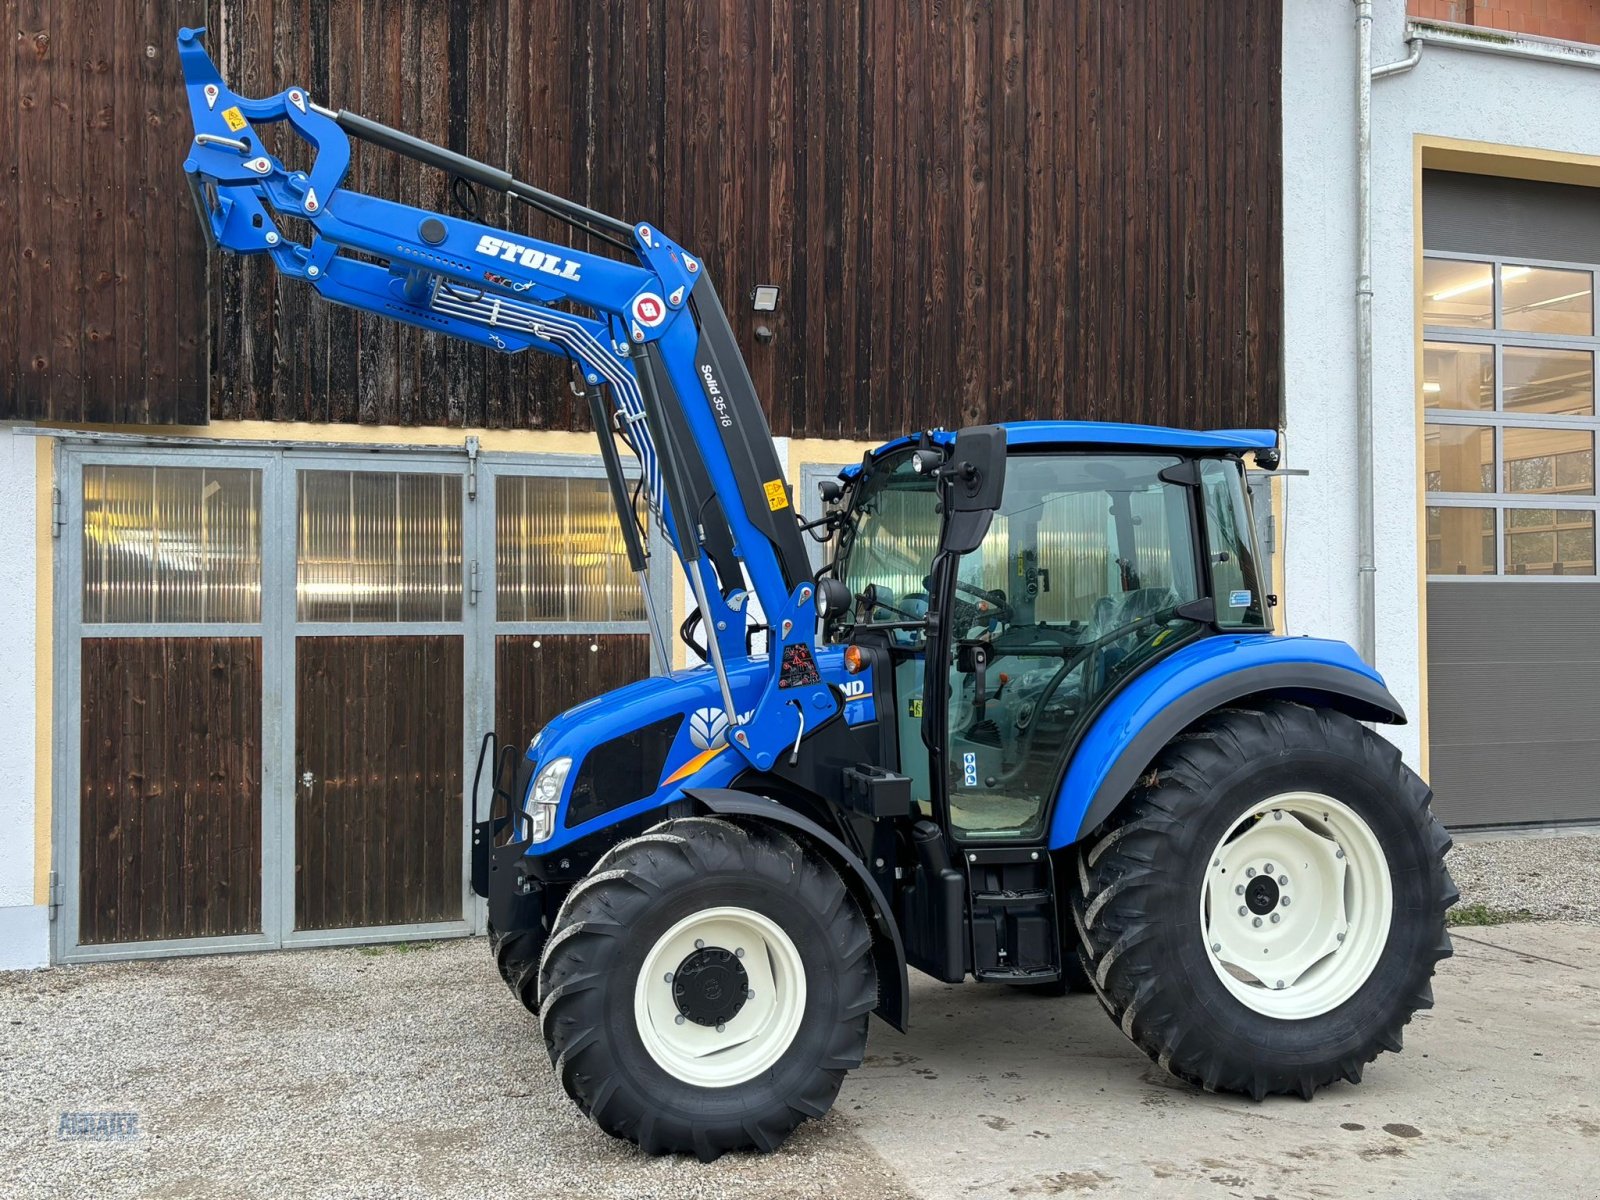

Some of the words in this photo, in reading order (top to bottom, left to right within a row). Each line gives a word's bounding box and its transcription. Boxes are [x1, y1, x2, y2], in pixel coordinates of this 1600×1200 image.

[475, 235, 582, 282] STOLL
[701, 364, 721, 395] Solid
[713, 396, 732, 427] 35-18
